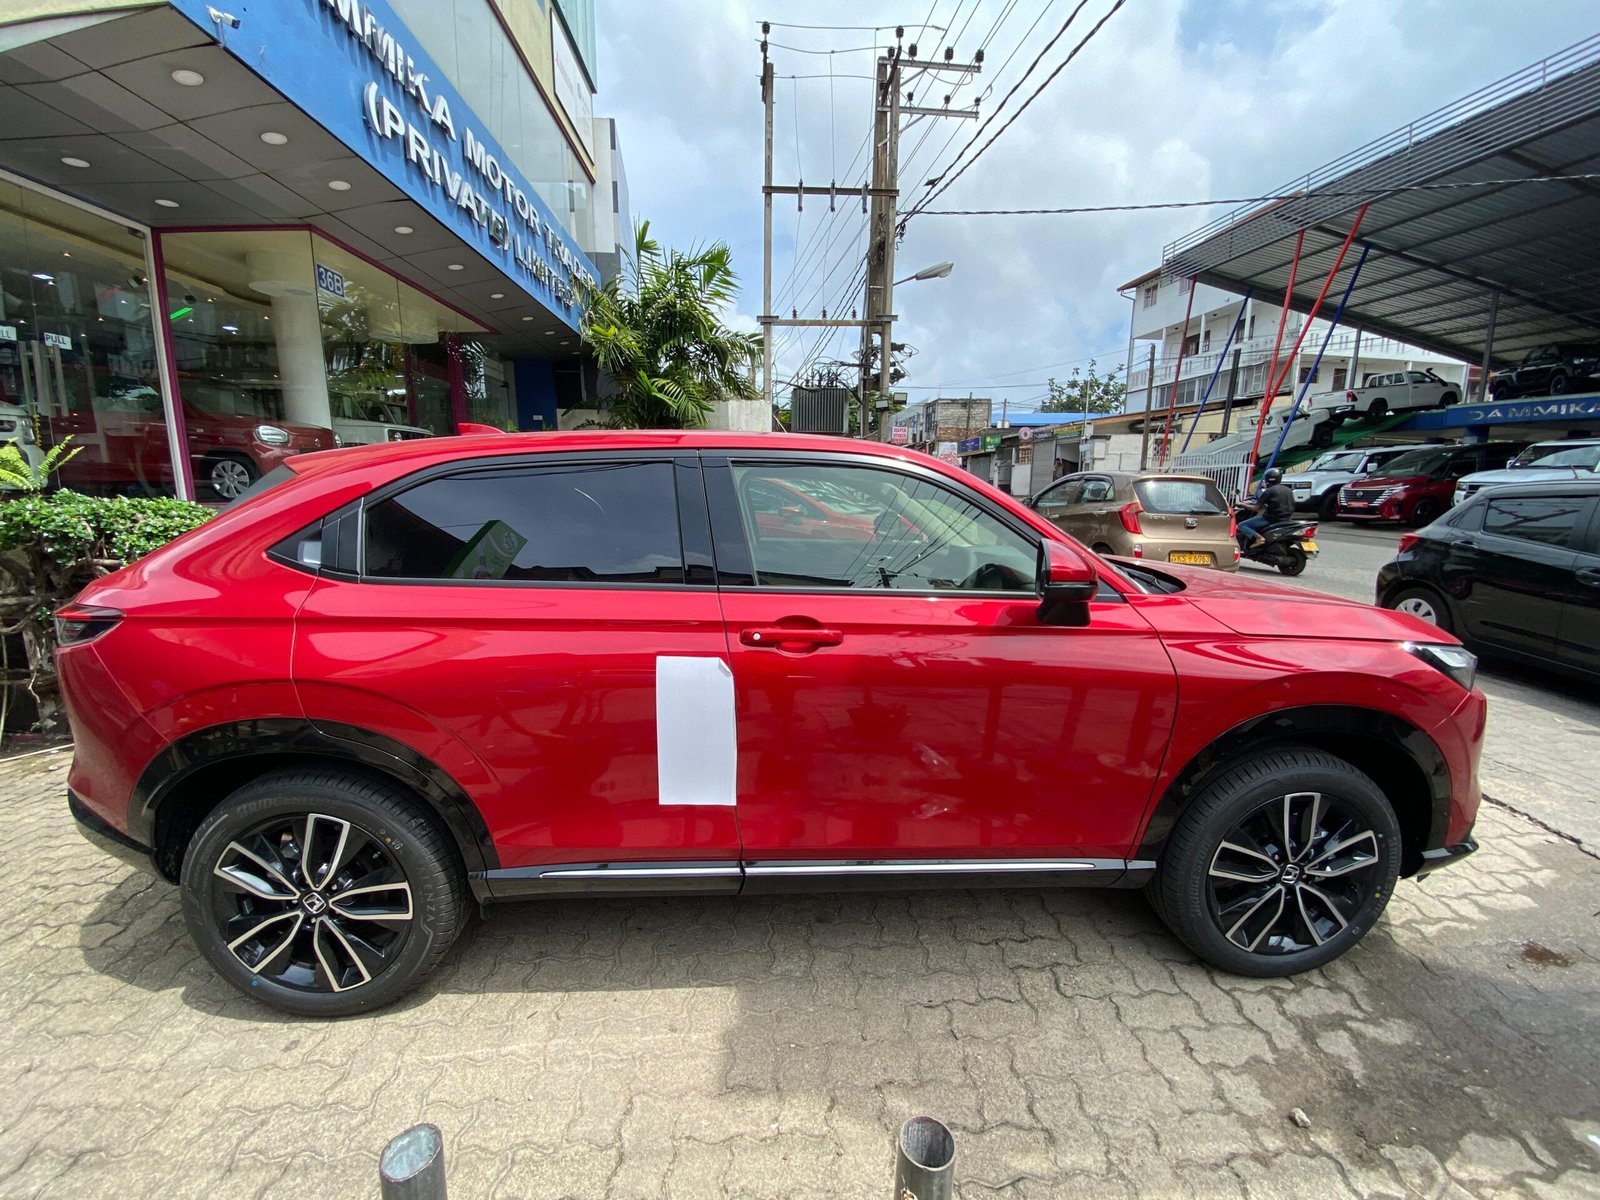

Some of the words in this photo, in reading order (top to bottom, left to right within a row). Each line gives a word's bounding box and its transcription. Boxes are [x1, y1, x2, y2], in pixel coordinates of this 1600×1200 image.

[363, 81, 511, 251] (PRIVATE)
[514, 233, 575, 308] LIMITED
[463, 127, 541, 237] MOTOR
[544, 221, 597, 291] TRADER
[319, 267, 343, 296] 36B
[45, 334, 66, 344] PULL
